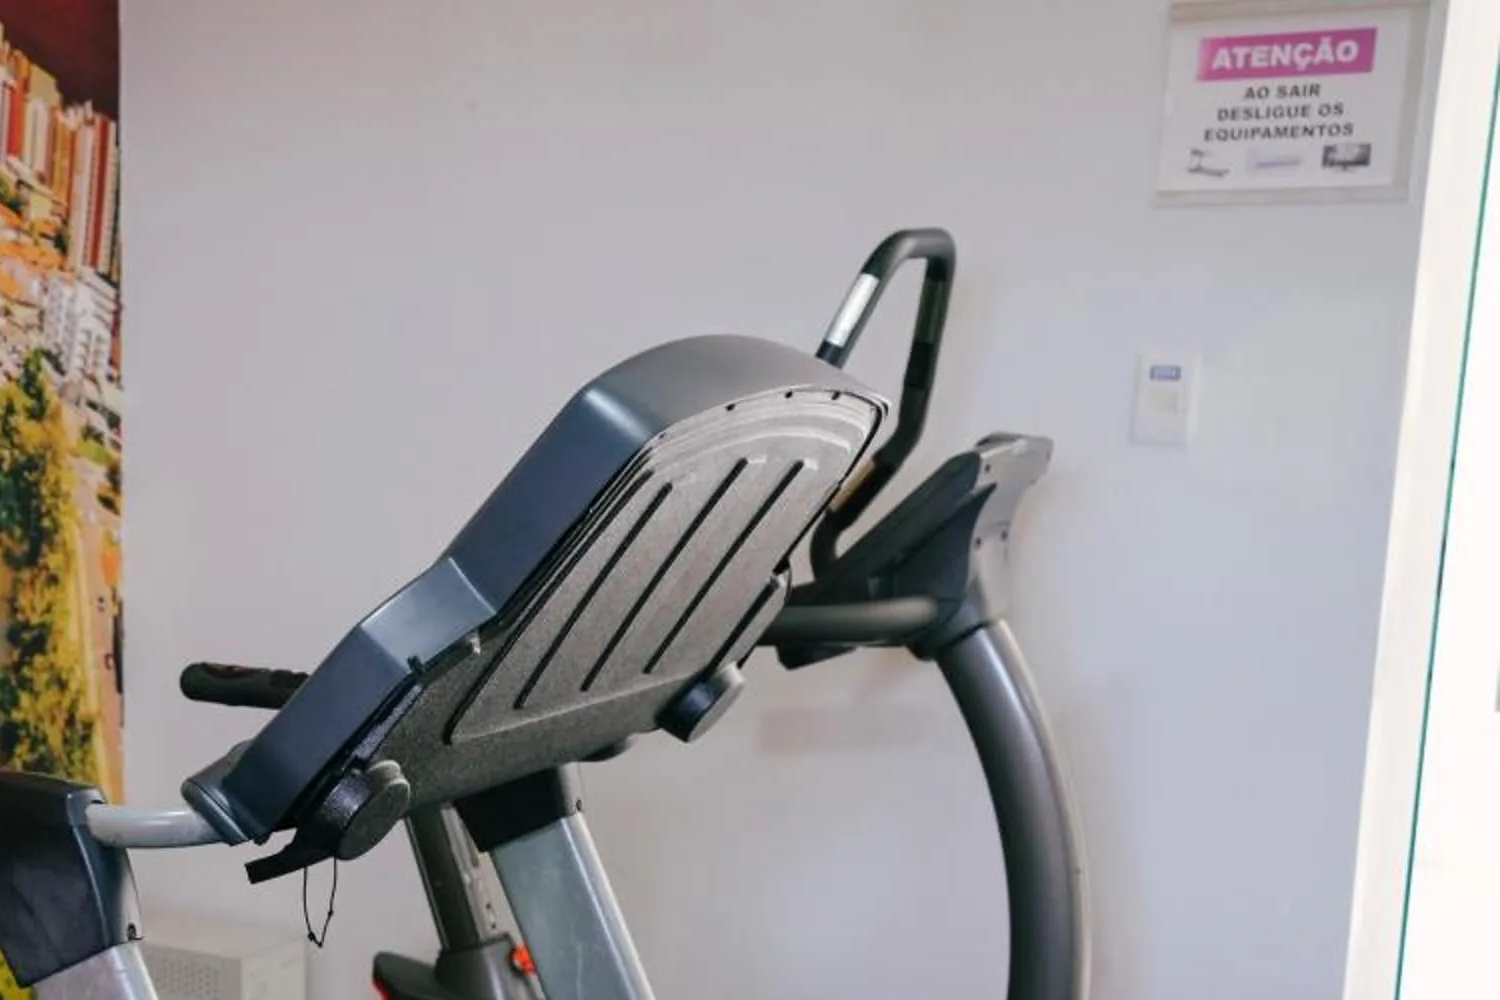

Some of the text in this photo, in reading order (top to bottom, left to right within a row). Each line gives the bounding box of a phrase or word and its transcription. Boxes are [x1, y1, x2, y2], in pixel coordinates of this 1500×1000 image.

[1212, 37, 1359, 70] ATENÇÃO
[1244, 83, 1321, 99] AO SAIR
[1217, 102, 1344, 122] DESLIGUE OS
[1205, 123, 1353, 141] EQUIPAMENTOS
